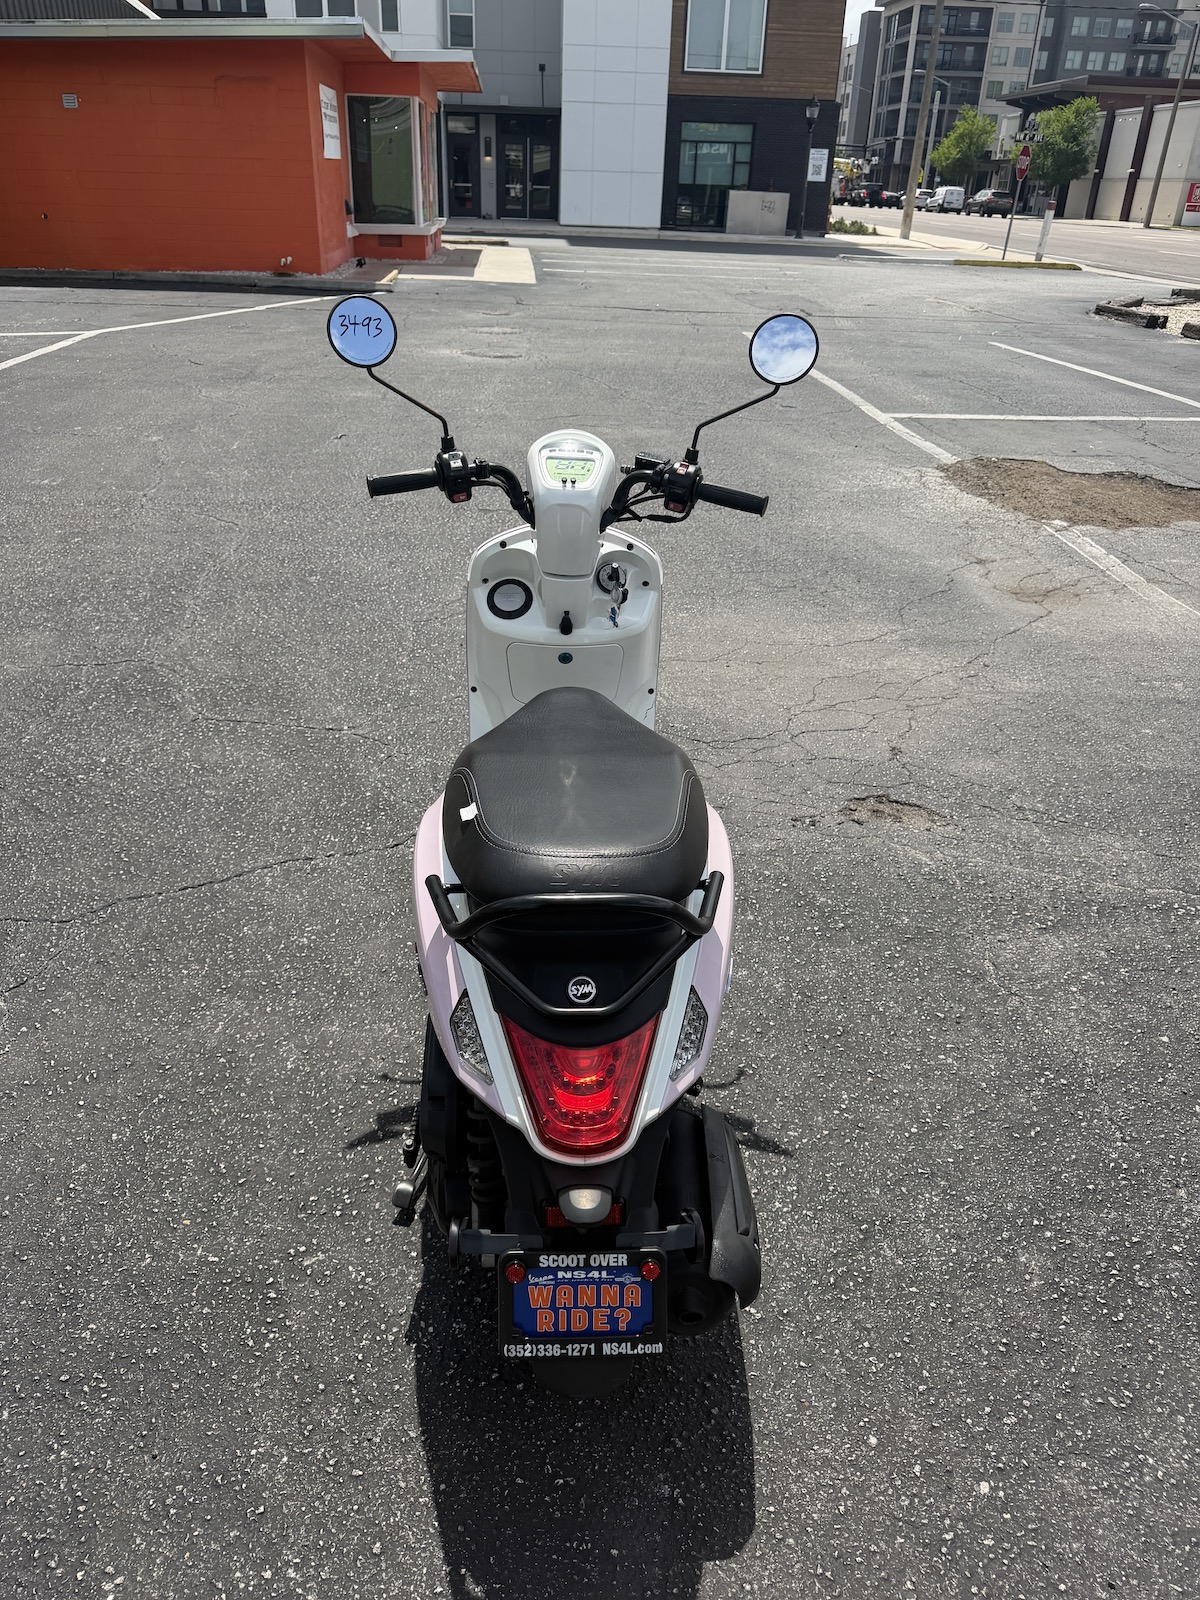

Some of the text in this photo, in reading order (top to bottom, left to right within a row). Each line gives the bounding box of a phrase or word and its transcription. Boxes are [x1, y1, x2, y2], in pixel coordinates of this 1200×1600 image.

[1017, 155, 1030, 169] STOP
[338, 314, 383, 338] 3493
[571, 984, 594, 997] SYM
[539, 1254, 627, 1267] SCOOT OVER
[528, 1274, 555, 1284] Vespa
[557, 1270, 615, 1279] NS4L
[527, 1284, 642, 1309] WANNA
[536, 1308, 632, 1332] RIDE?
[503, 1342, 663, 1358] (352)336-1271 NS4L.com
